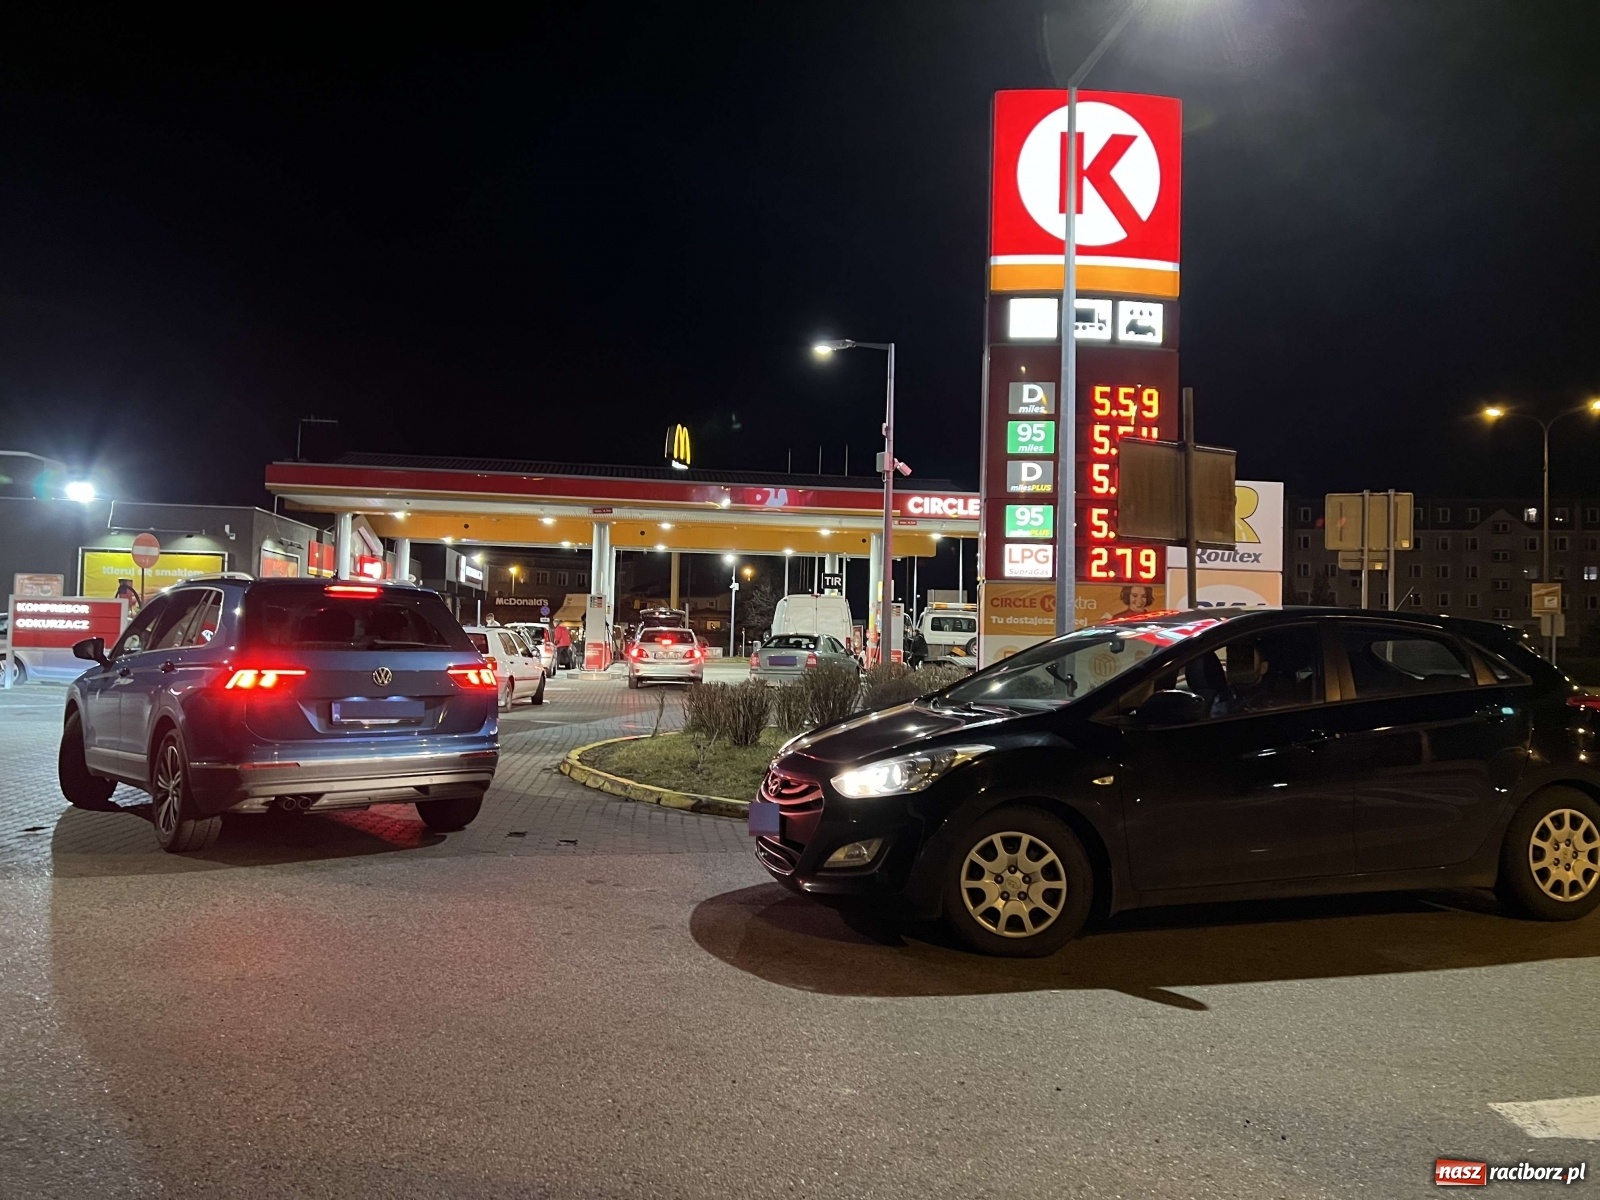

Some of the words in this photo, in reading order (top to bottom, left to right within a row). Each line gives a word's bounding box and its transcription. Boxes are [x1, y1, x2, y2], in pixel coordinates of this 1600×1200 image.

[1058, 131, 1147, 237] K
[1022, 384, 1044, 403] D
[1018, 405, 1046, 413] miles
[1094, 386, 1159, 418] 5.59
[1017, 423, 1046, 442] 95
[1017, 444, 1044, 452] miles
[1021, 462, 1042, 481] D
[907, 496, 980, 516] CIRCLE
[1015, 507, 1044, 526] 95
[1008, 548, 1050, 564] LPG
[1091, 547, 1156, 579] 2.79
[1196, 549, 1263, 564] Routex
[1009, 568, 1049, 576] SupraGas
[824, 576, 842, 586] TIR
[495, 597, 549, 606] McDonald's
[990, 597, 1037, 609] CIRCLE
[1075, 596, 1097, 609] xtra
[15, 618, 90, 629] ODKURZACZ
[991, 615, 1004, 624] Tu
[1006, 616, 1054, 625] dostajesz
